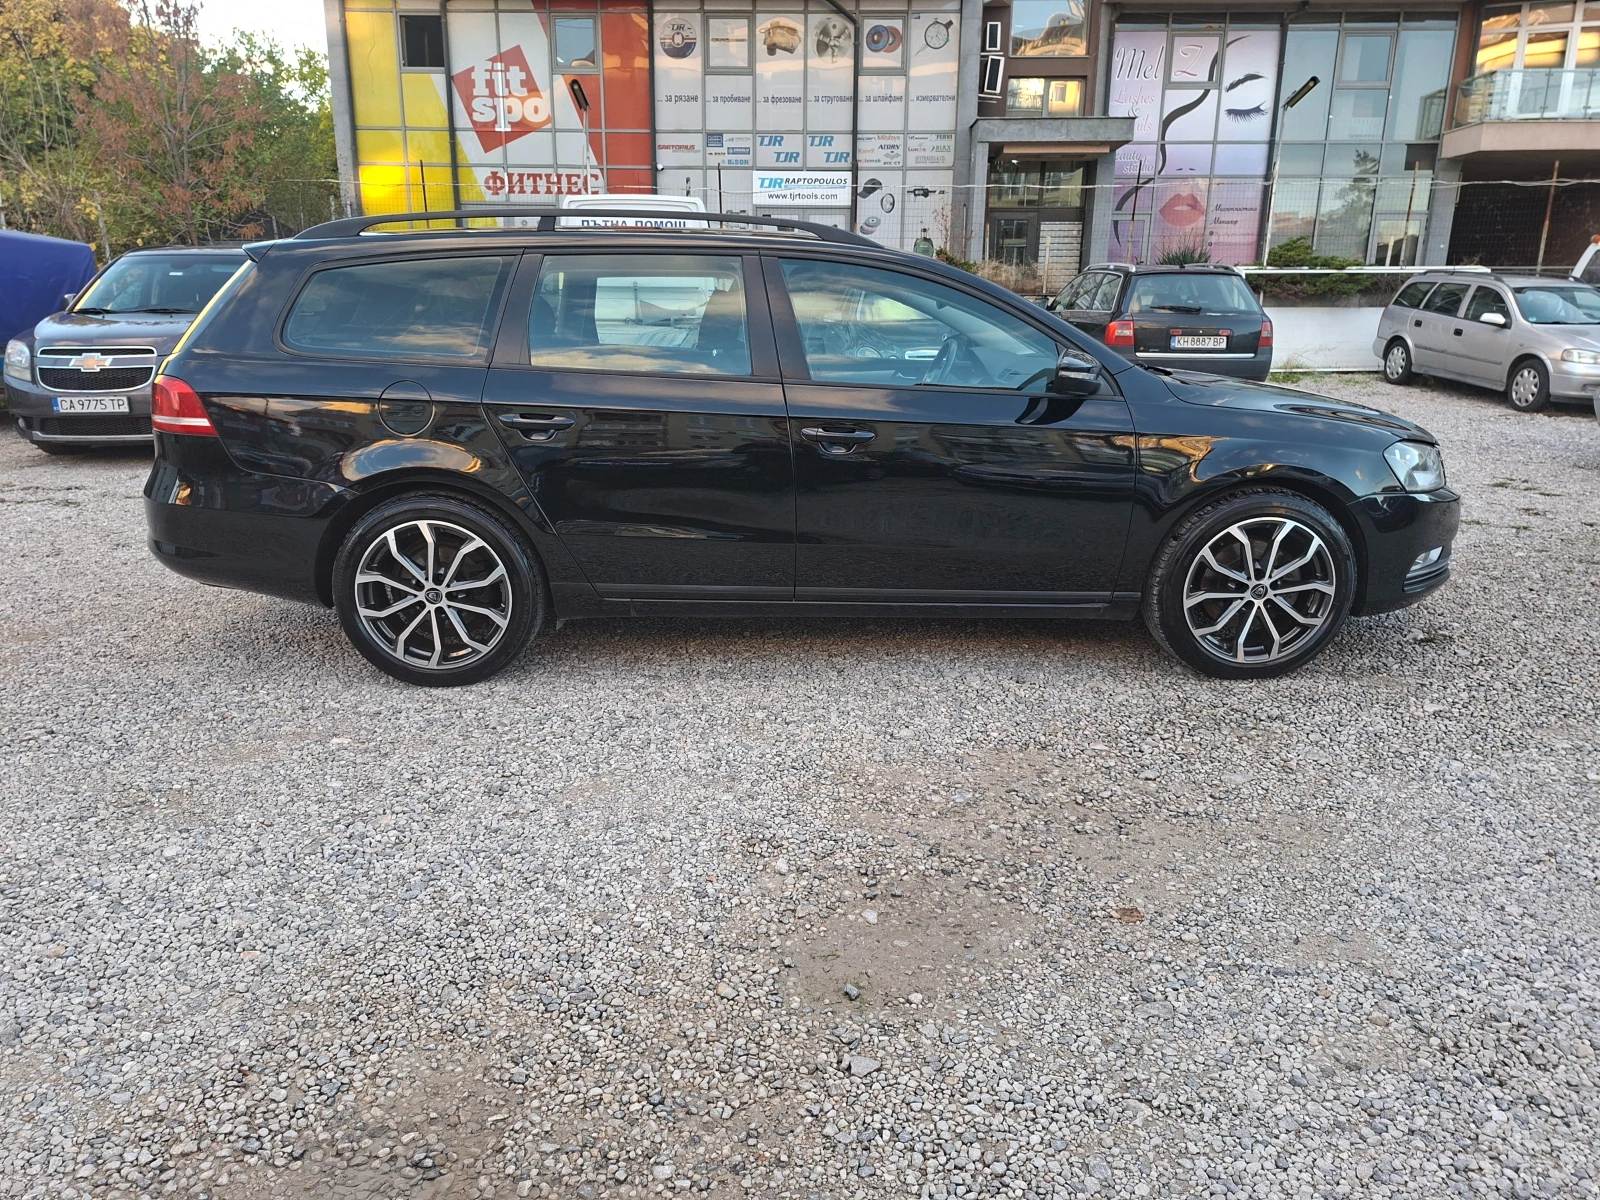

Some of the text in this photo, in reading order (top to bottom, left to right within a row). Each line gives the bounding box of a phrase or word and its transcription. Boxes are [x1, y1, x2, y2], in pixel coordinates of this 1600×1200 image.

[1115, 45, 1164, 80] Mel
[471, 60, 528, 97] fit
[674, 94, 699, 104] рязане
[720, 94, 750, 104] пробиване
[770, 95, 802, 104] фрезоване
[872, 94, 903, 104] шлайфане
[1113, 86, 1155, 106] Lashes
[758, 136, 784, 146] TJR
[809, 136, 834, 147] TJR
[774, 152, 800, 163] TJR
[824, 152, 850, 163] TJR
[1115, 150, 1142, 165] eauty
[484, 171, 600, 196] ФИТНЕС
[758, 178, 784, 188] TJR
[768, 192, 838, 201] www.tjrtools.com
[1177, 338, 1224, 346] KH 8887 BP
[60, 399, 125, 410] CA 9775 TP
